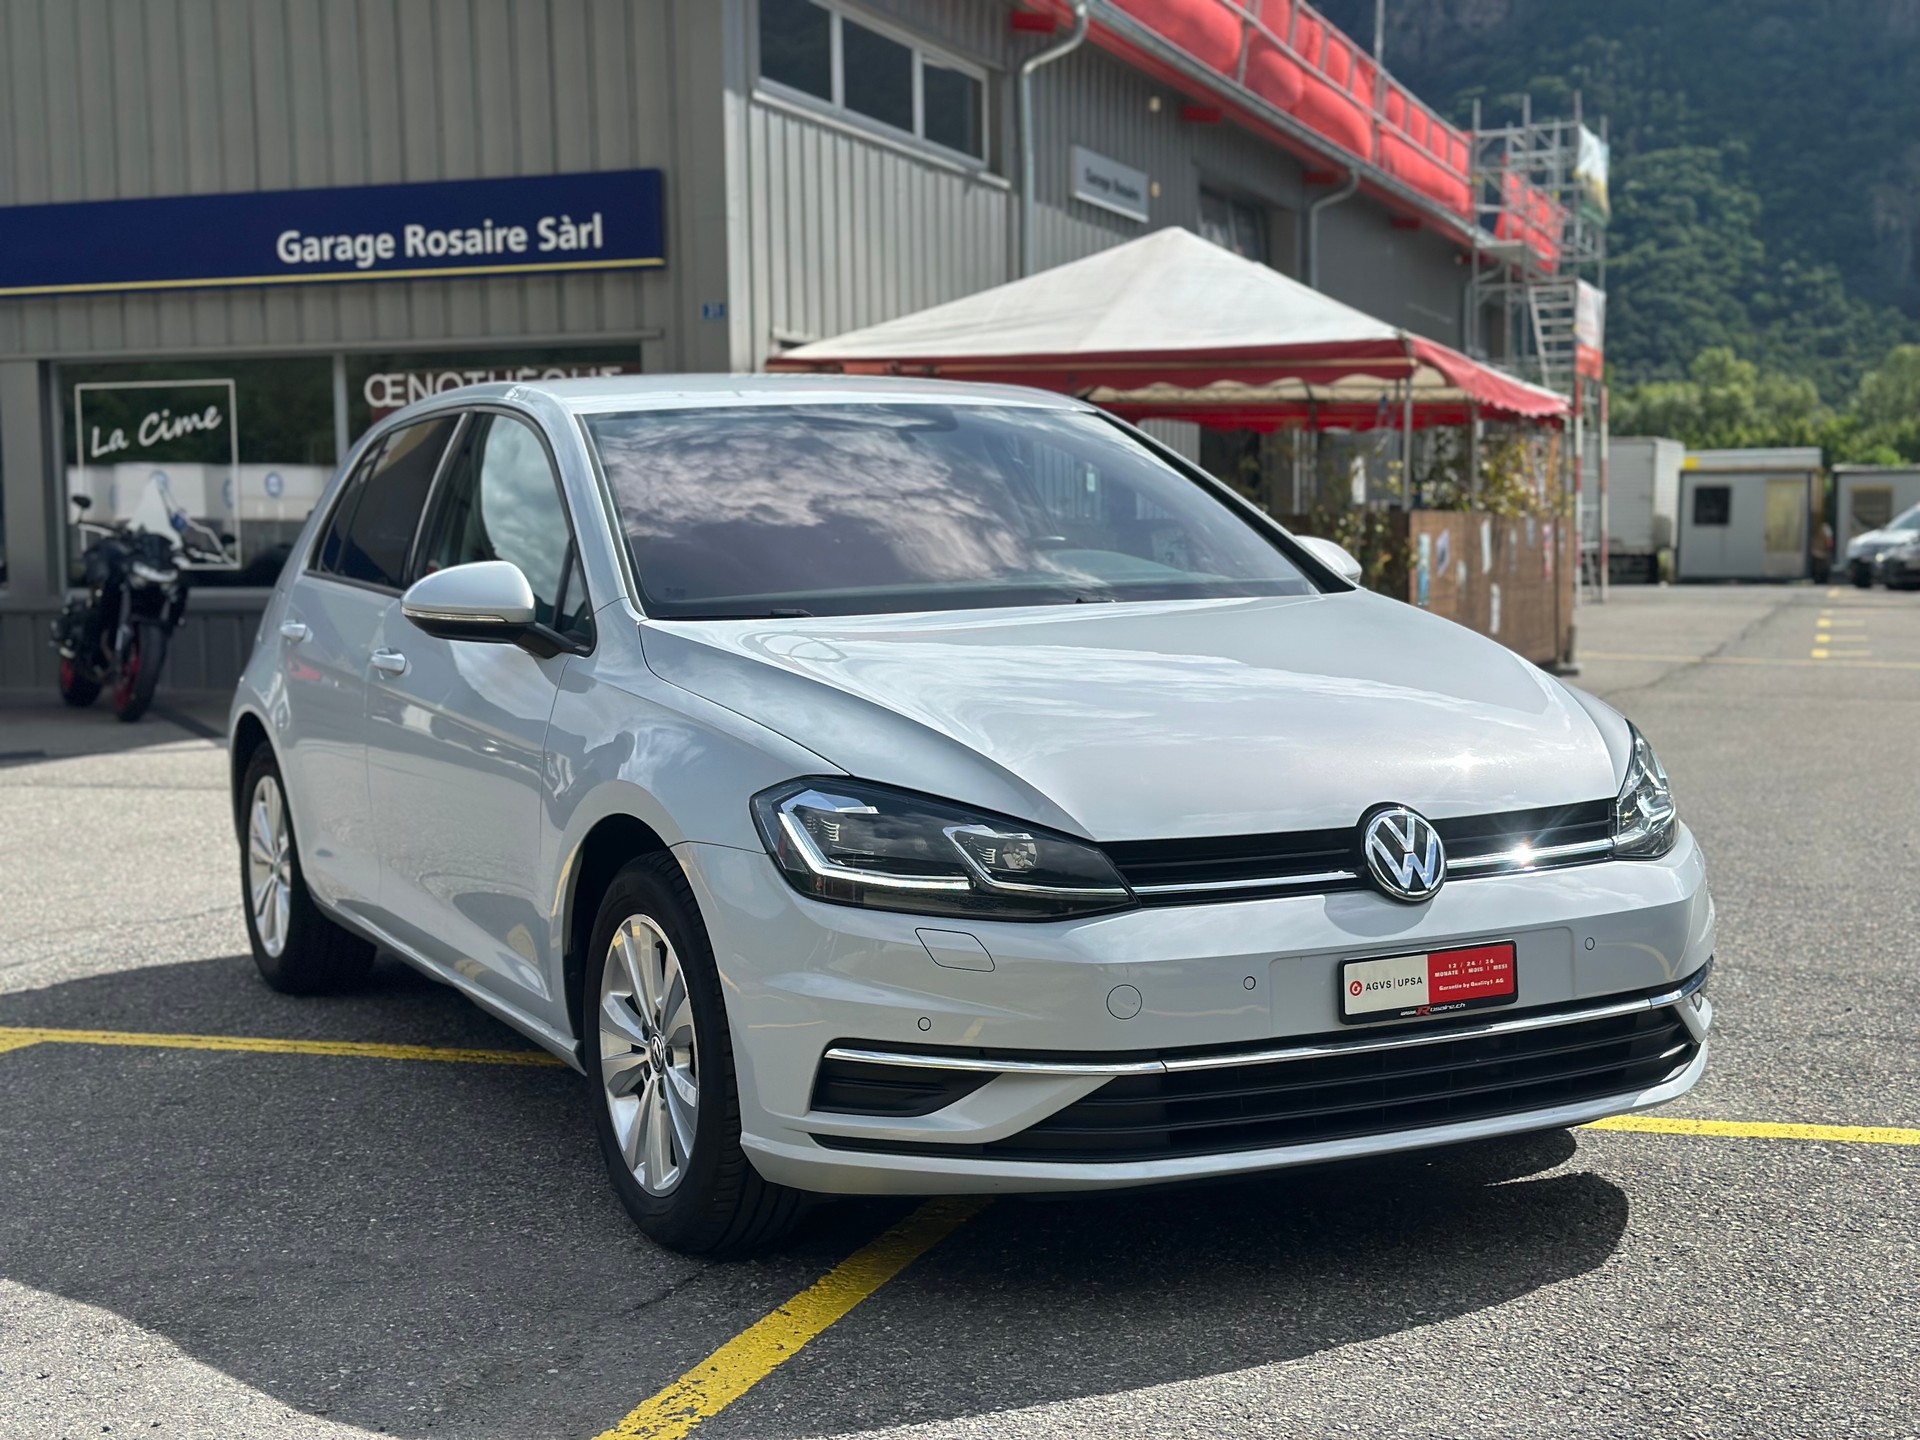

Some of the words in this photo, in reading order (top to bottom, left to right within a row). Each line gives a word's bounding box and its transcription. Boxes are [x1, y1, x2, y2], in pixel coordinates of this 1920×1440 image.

[276, 229, 396, 270] Garage
[404, 218, 529, 258] Rosaire
[537, 211, 604, 252] Sàrl
[90, 425, 130, 458] La
[138, 405, 223, 447] Cime
[1365, 808, 1446, 901] VW
[1365, 980, 1392, 992] AGVS
[1397, 976, 1423, 987] UPSA
[1434, 969, 1459, 978] MONATE
[1468, 966, 1484, 974] MOIS
